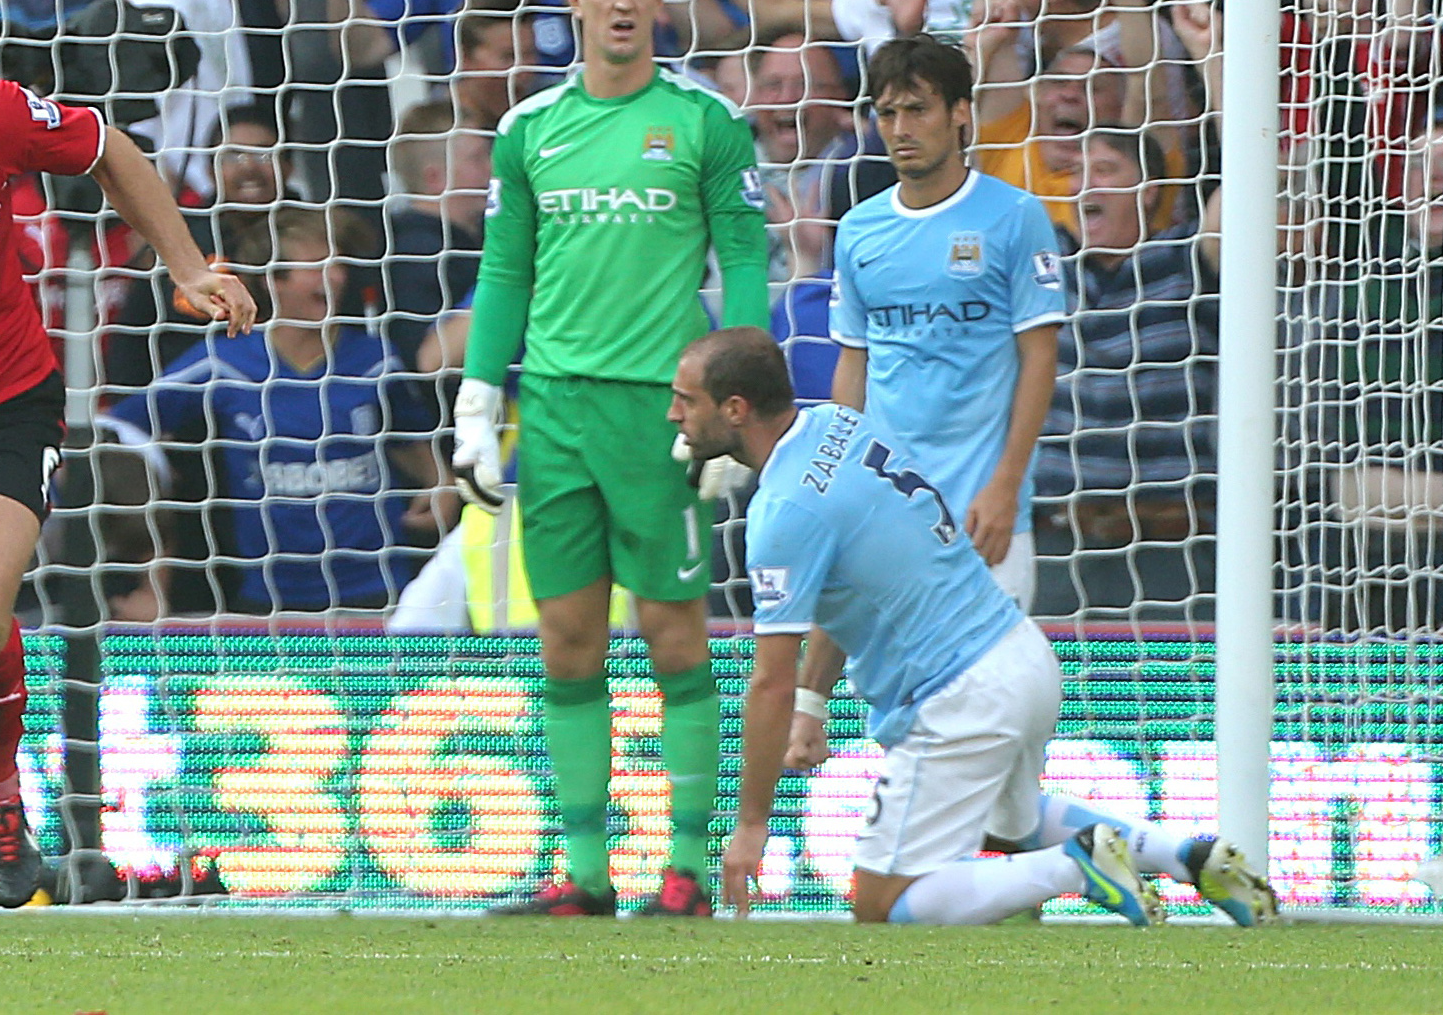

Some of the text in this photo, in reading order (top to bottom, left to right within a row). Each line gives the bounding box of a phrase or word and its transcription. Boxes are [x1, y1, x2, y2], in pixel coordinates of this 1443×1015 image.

[537, 186, 678, 214] ETIHAD
[861, 438, 957, 546] 5
[682, 505, 700, 561] 1
